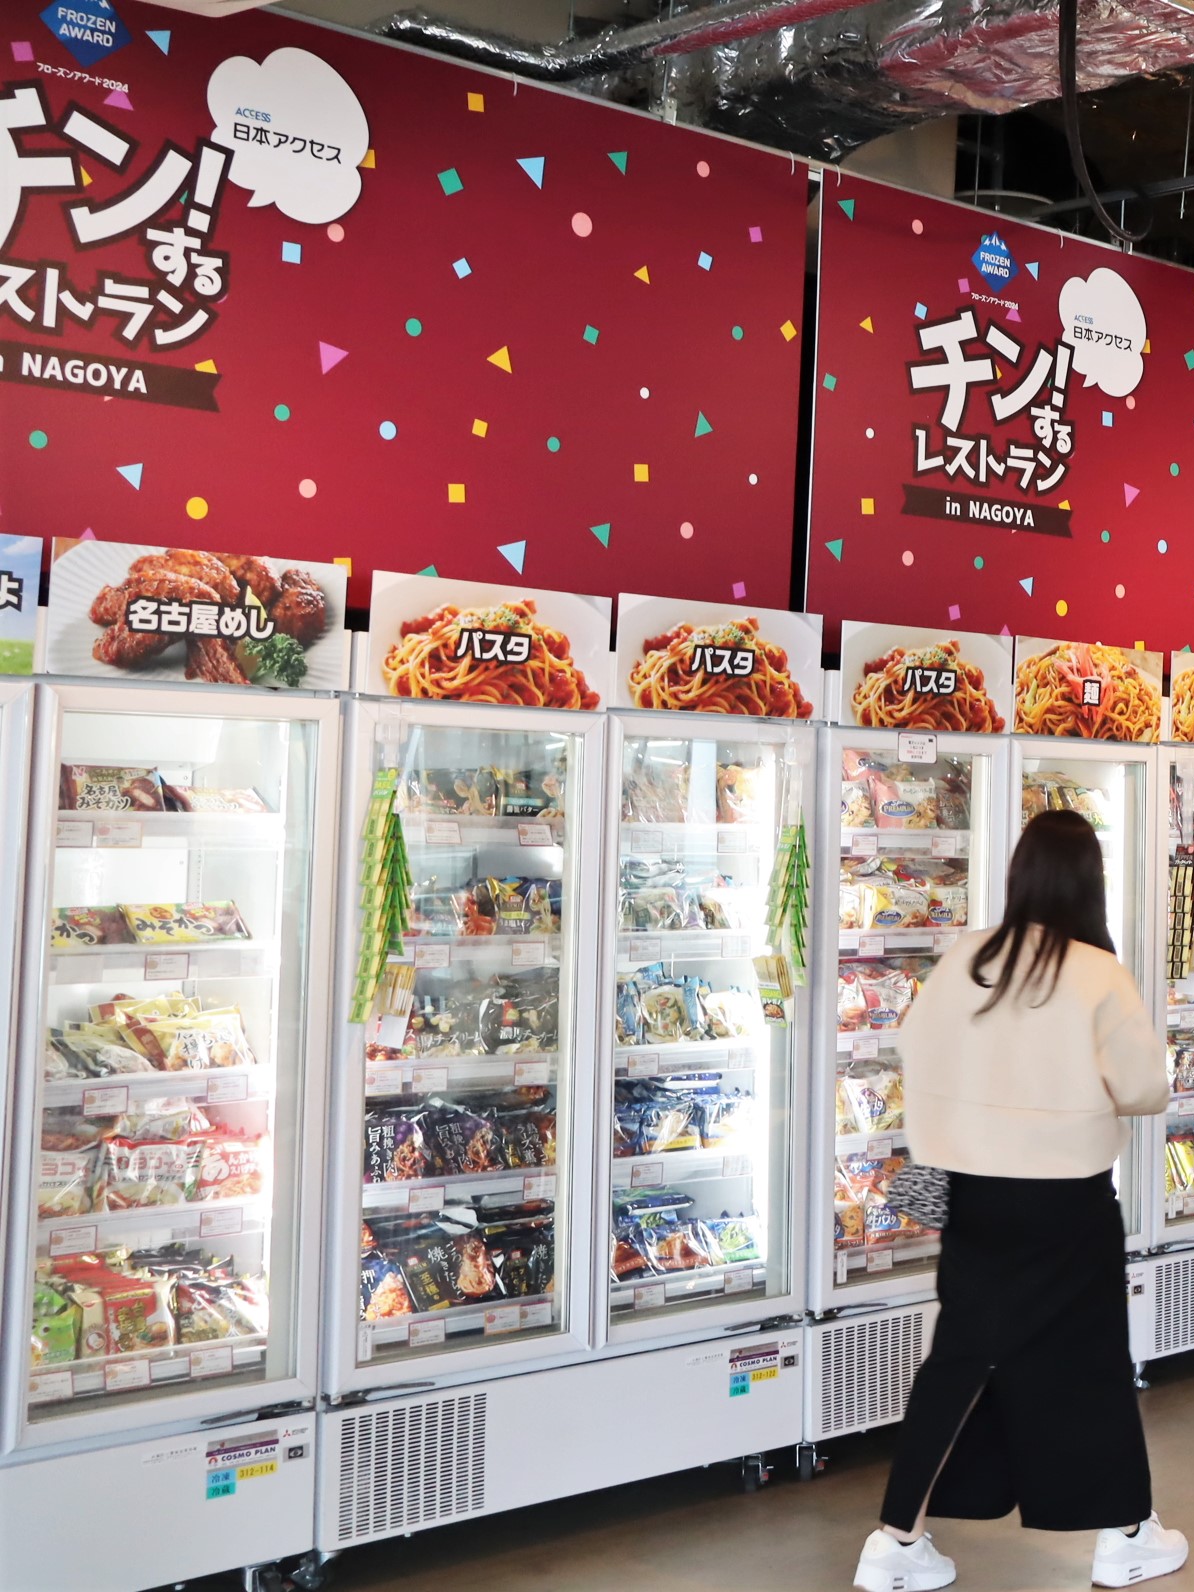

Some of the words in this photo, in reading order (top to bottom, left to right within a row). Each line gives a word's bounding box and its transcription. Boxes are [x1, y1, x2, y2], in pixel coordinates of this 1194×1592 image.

[57, 8, 117, 33] FROZEN
[59, 23, 114, 47] AWARD
[36, 62, 129, 93] フローズンアワード2024
[235, 107, 272, 123] ACCESS
[233, 122, 342, 164] 日本アクセス
[146, 227, 224, 296] する
[980, 251, 1011, 268] FROZEN
[981, 262, 1010, 278] AWARD
[1073, 326, 1133, 352] 日本アクセス
[21, 352, 148, 393] NAGOYA
[1031, 405, 1072, 454] する
[915, 428, 1065, 492] レストラン
[945, 497, 961, 516] in
[968, 500, 1035, 527] NAGOYA
[129, 600, 275, 640] 名古屋めし
[457, 631, 531, 662] パスタ
[692, 648, 754, 676] パスタ
[905, 668, 956, 694] パスタ
[1084, 681, 1100, 704] 麺
[77, 795, 131, 811] みそカツ
[84, 783, 120, 798] 名古屋
[135, 914, 214, 936] みそかつ
[382, 1125, 399, 1177] 粗挽き肉
[739, 1360, 761, 1368] COSMO
[762, 1355, 778, 1363] PLAN
[221, 1450, 252, 1462] COSMO
[255, 1446, 276, 1456] PLAN
[239, 1464, 275, 1478] 312-114
